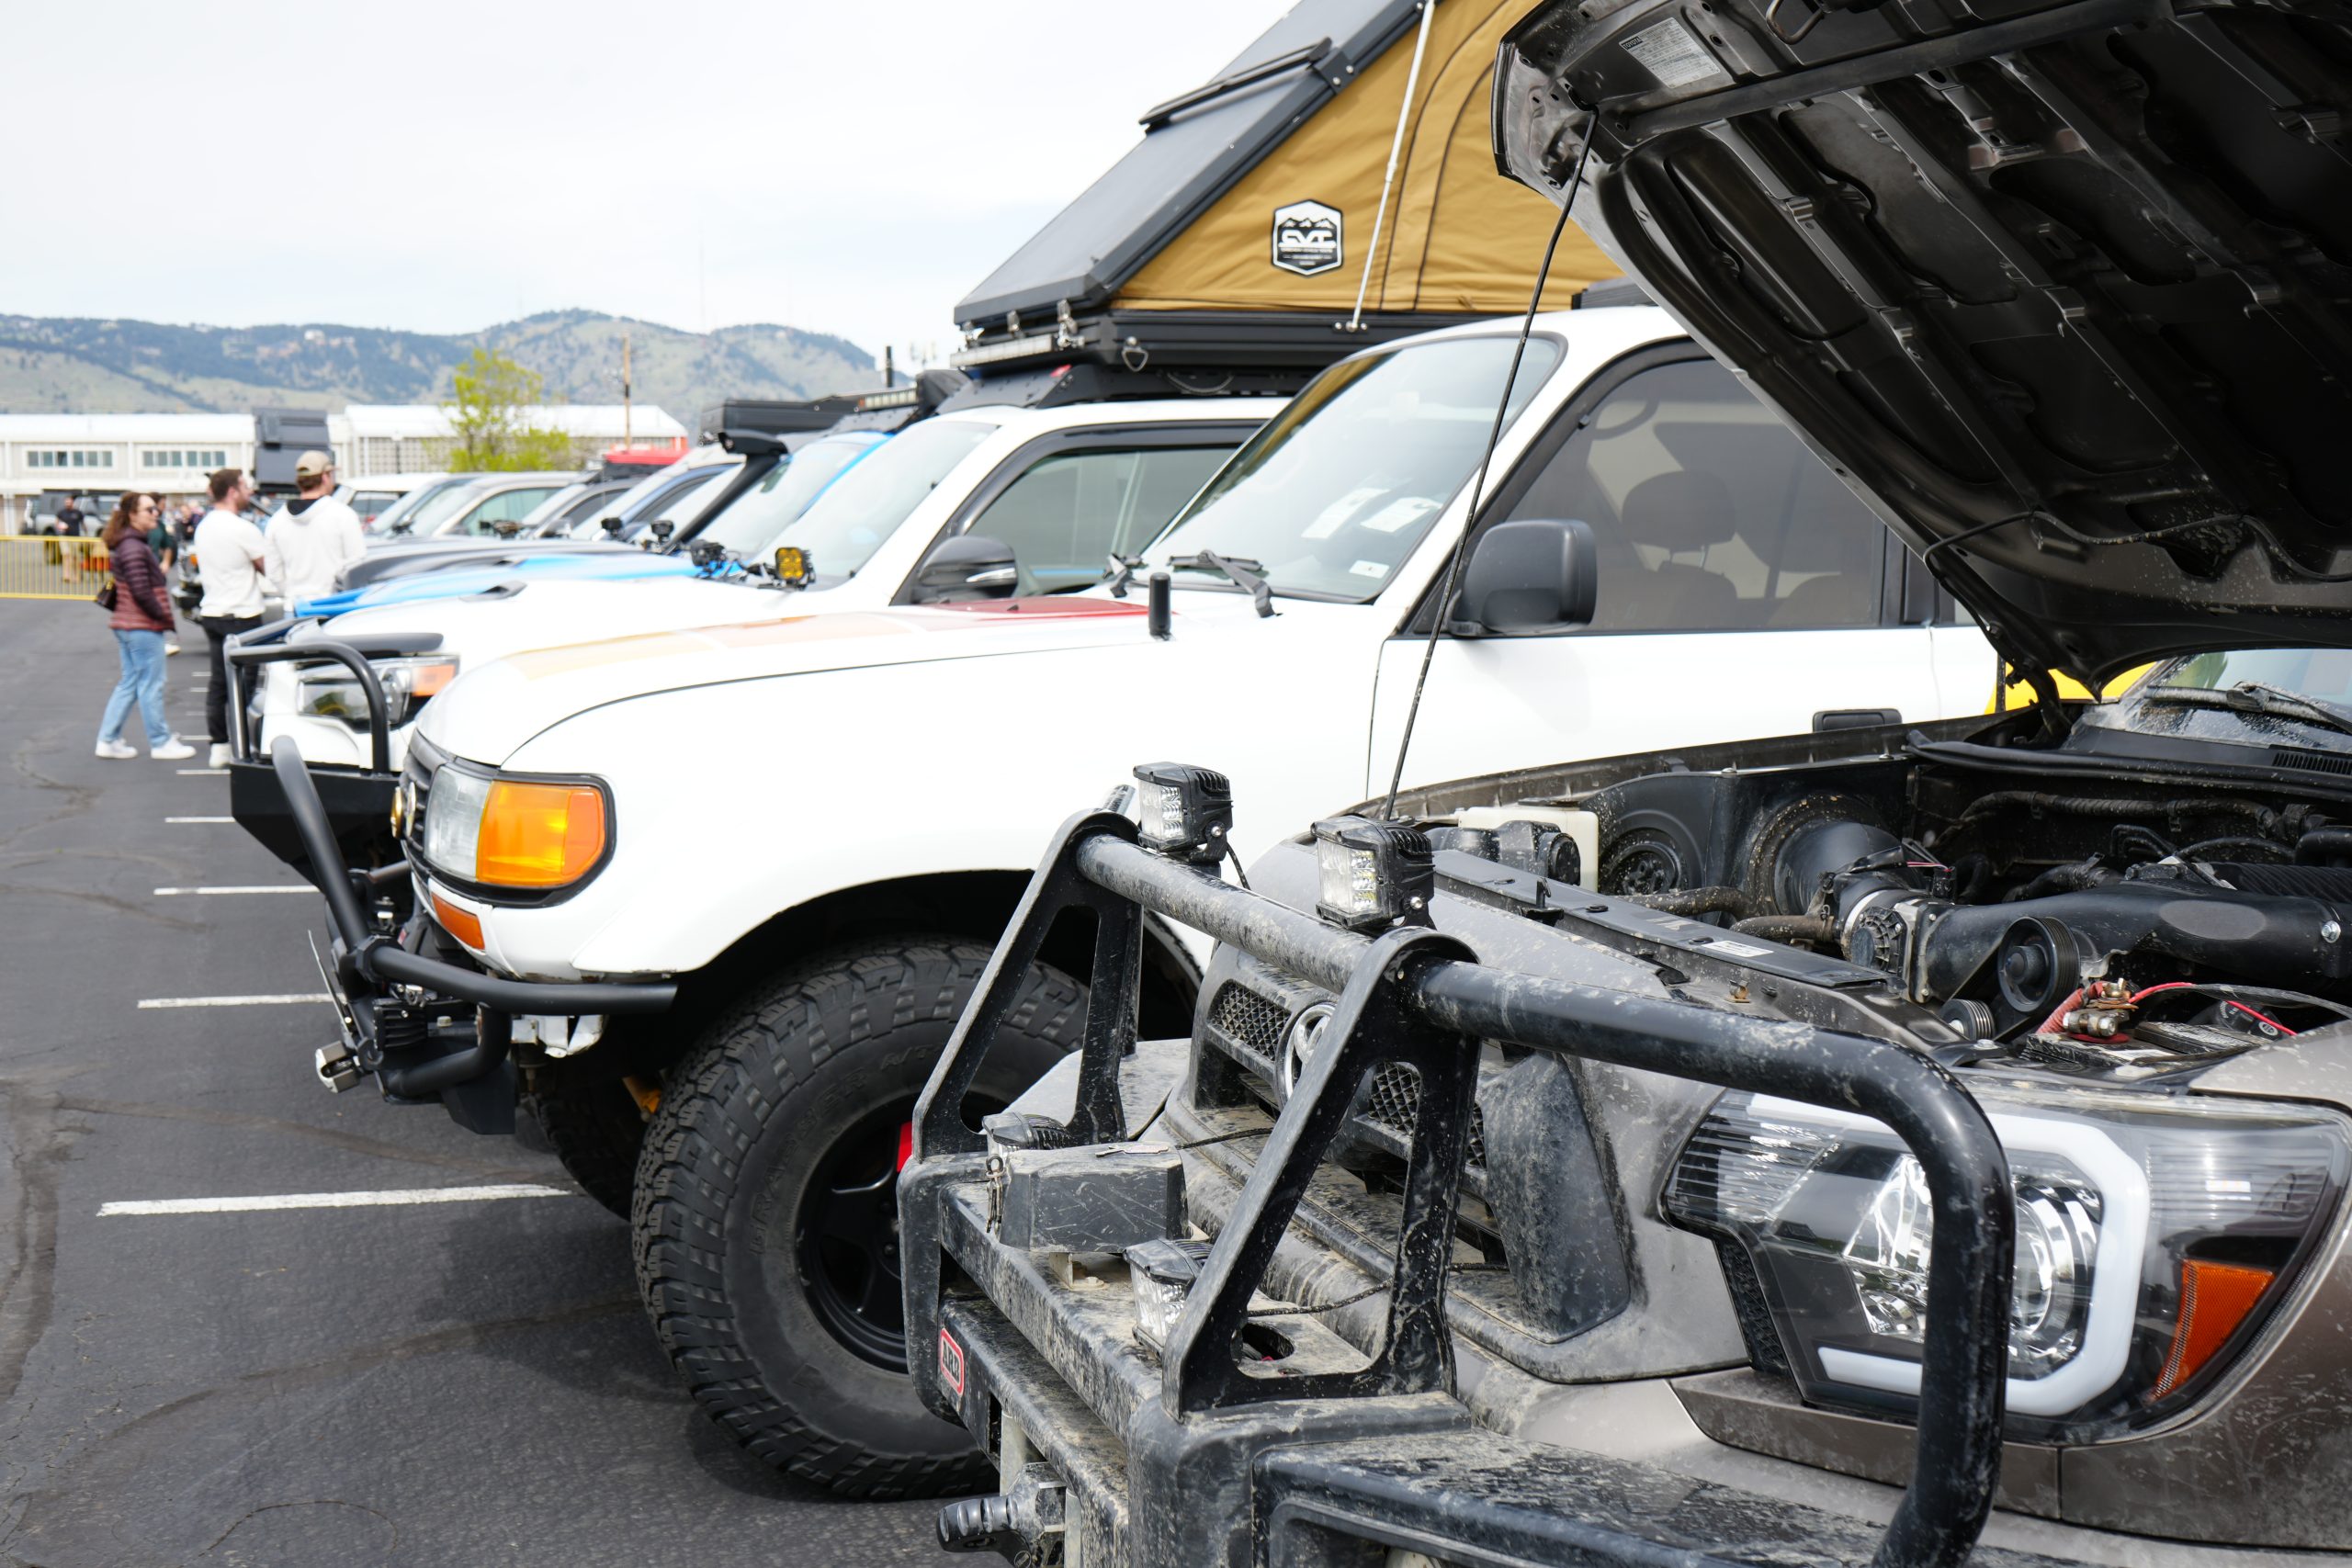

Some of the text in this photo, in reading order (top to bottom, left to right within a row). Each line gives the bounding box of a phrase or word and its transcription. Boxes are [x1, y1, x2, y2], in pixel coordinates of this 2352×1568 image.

[1623, 37, 1644, 50] TOYOTA
[749, 1066, 867, 1256] GRABBER
[943, 1338, 961, 1385] ARB
